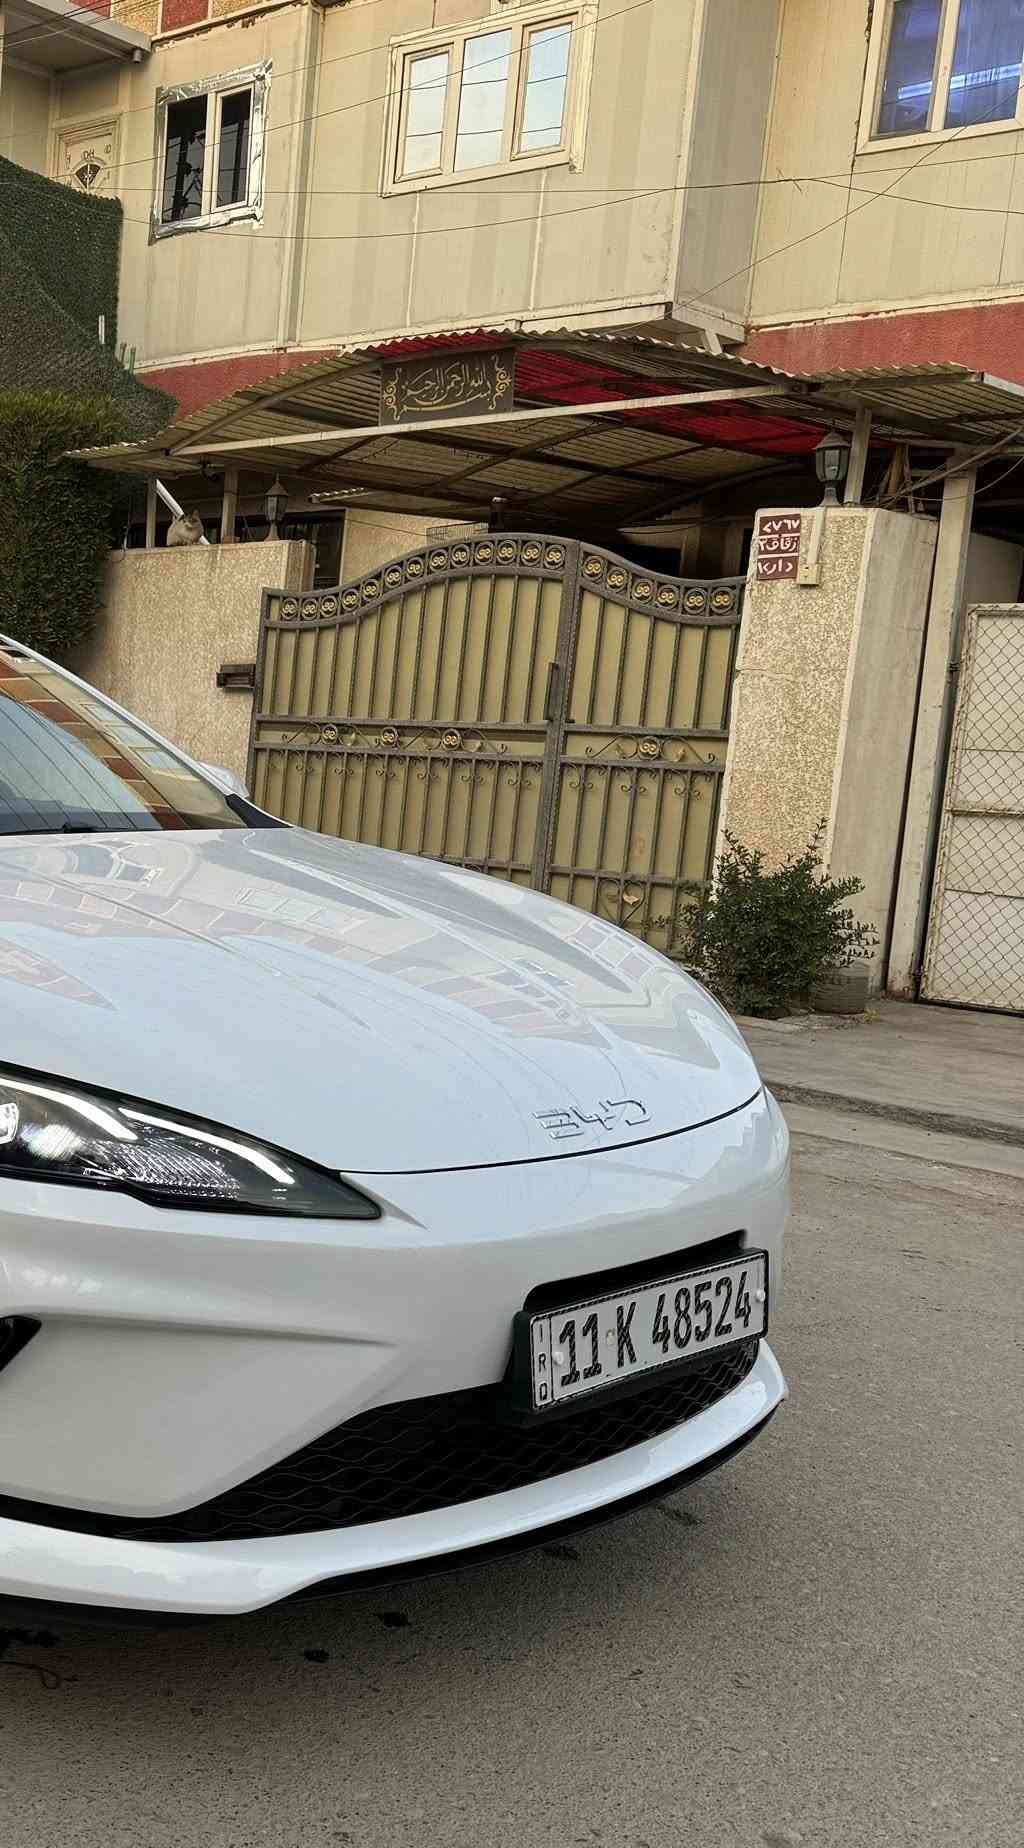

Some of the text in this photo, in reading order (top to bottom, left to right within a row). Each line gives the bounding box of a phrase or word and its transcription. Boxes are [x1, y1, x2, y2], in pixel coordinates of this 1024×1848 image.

[532, 1099, 652, 1140] BYD
[559, 1271, 752, 1387] 11 K 48524
